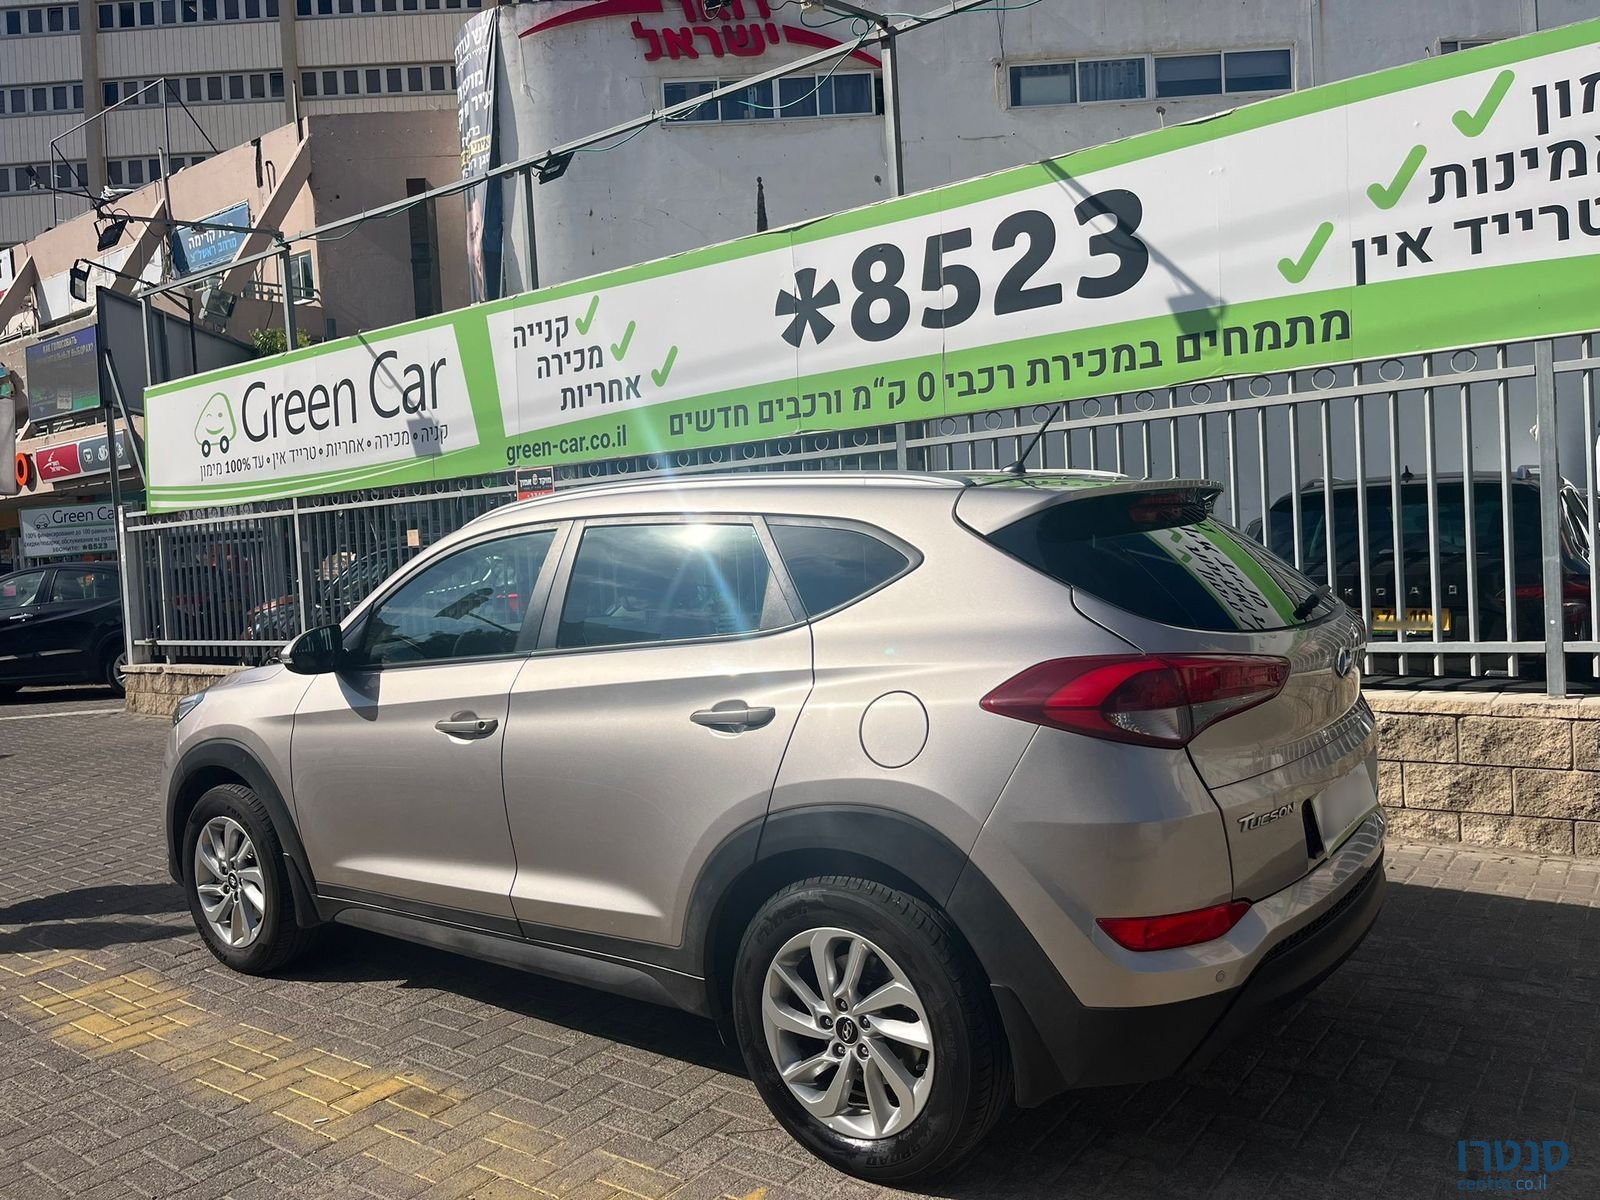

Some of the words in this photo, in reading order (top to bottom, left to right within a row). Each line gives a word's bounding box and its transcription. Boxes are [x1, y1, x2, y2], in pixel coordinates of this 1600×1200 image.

[631, 21, 780, 61] ישראל
[1428, 135, 1600, 204] מינות
[188, 230, 216, 250] קדימה
[1351, 226, 1434, 286] אין
[513, 315, 569, 349] קנייה
[1177, 309, 1351, 364] מתמחים
[537, 345, 604, 379] מכירה
[1026, 340, 1162, 387] במכירת
[241, 378, 358, 443] Green
[369, 350, 447, 419] Car
[560, 375, 642, 411] אחריות
[917, 371, 936, 402] 0
[945, 363, 1015, 398] רכבי
[669, 403, 749, 436] חדשים
[758, 390, 842, 424] ורכבים
[325, 437, 365, 458] אחריות
[374, 430, 411, 450] מכירה
[421, 424, 449, 446] קניה
[506, 424, 627, 466] green-car.co.il
[225, 457, 251, 474] 100%
[252, 455, 265, 469] עד
[271, 450, 287, 470] אין
[289, 445, 317, 463] טרייד
[200, 462, 223, 482] מימון
[52, 509, 94, 524] Green
[97, 506, 115, 521] Ca
